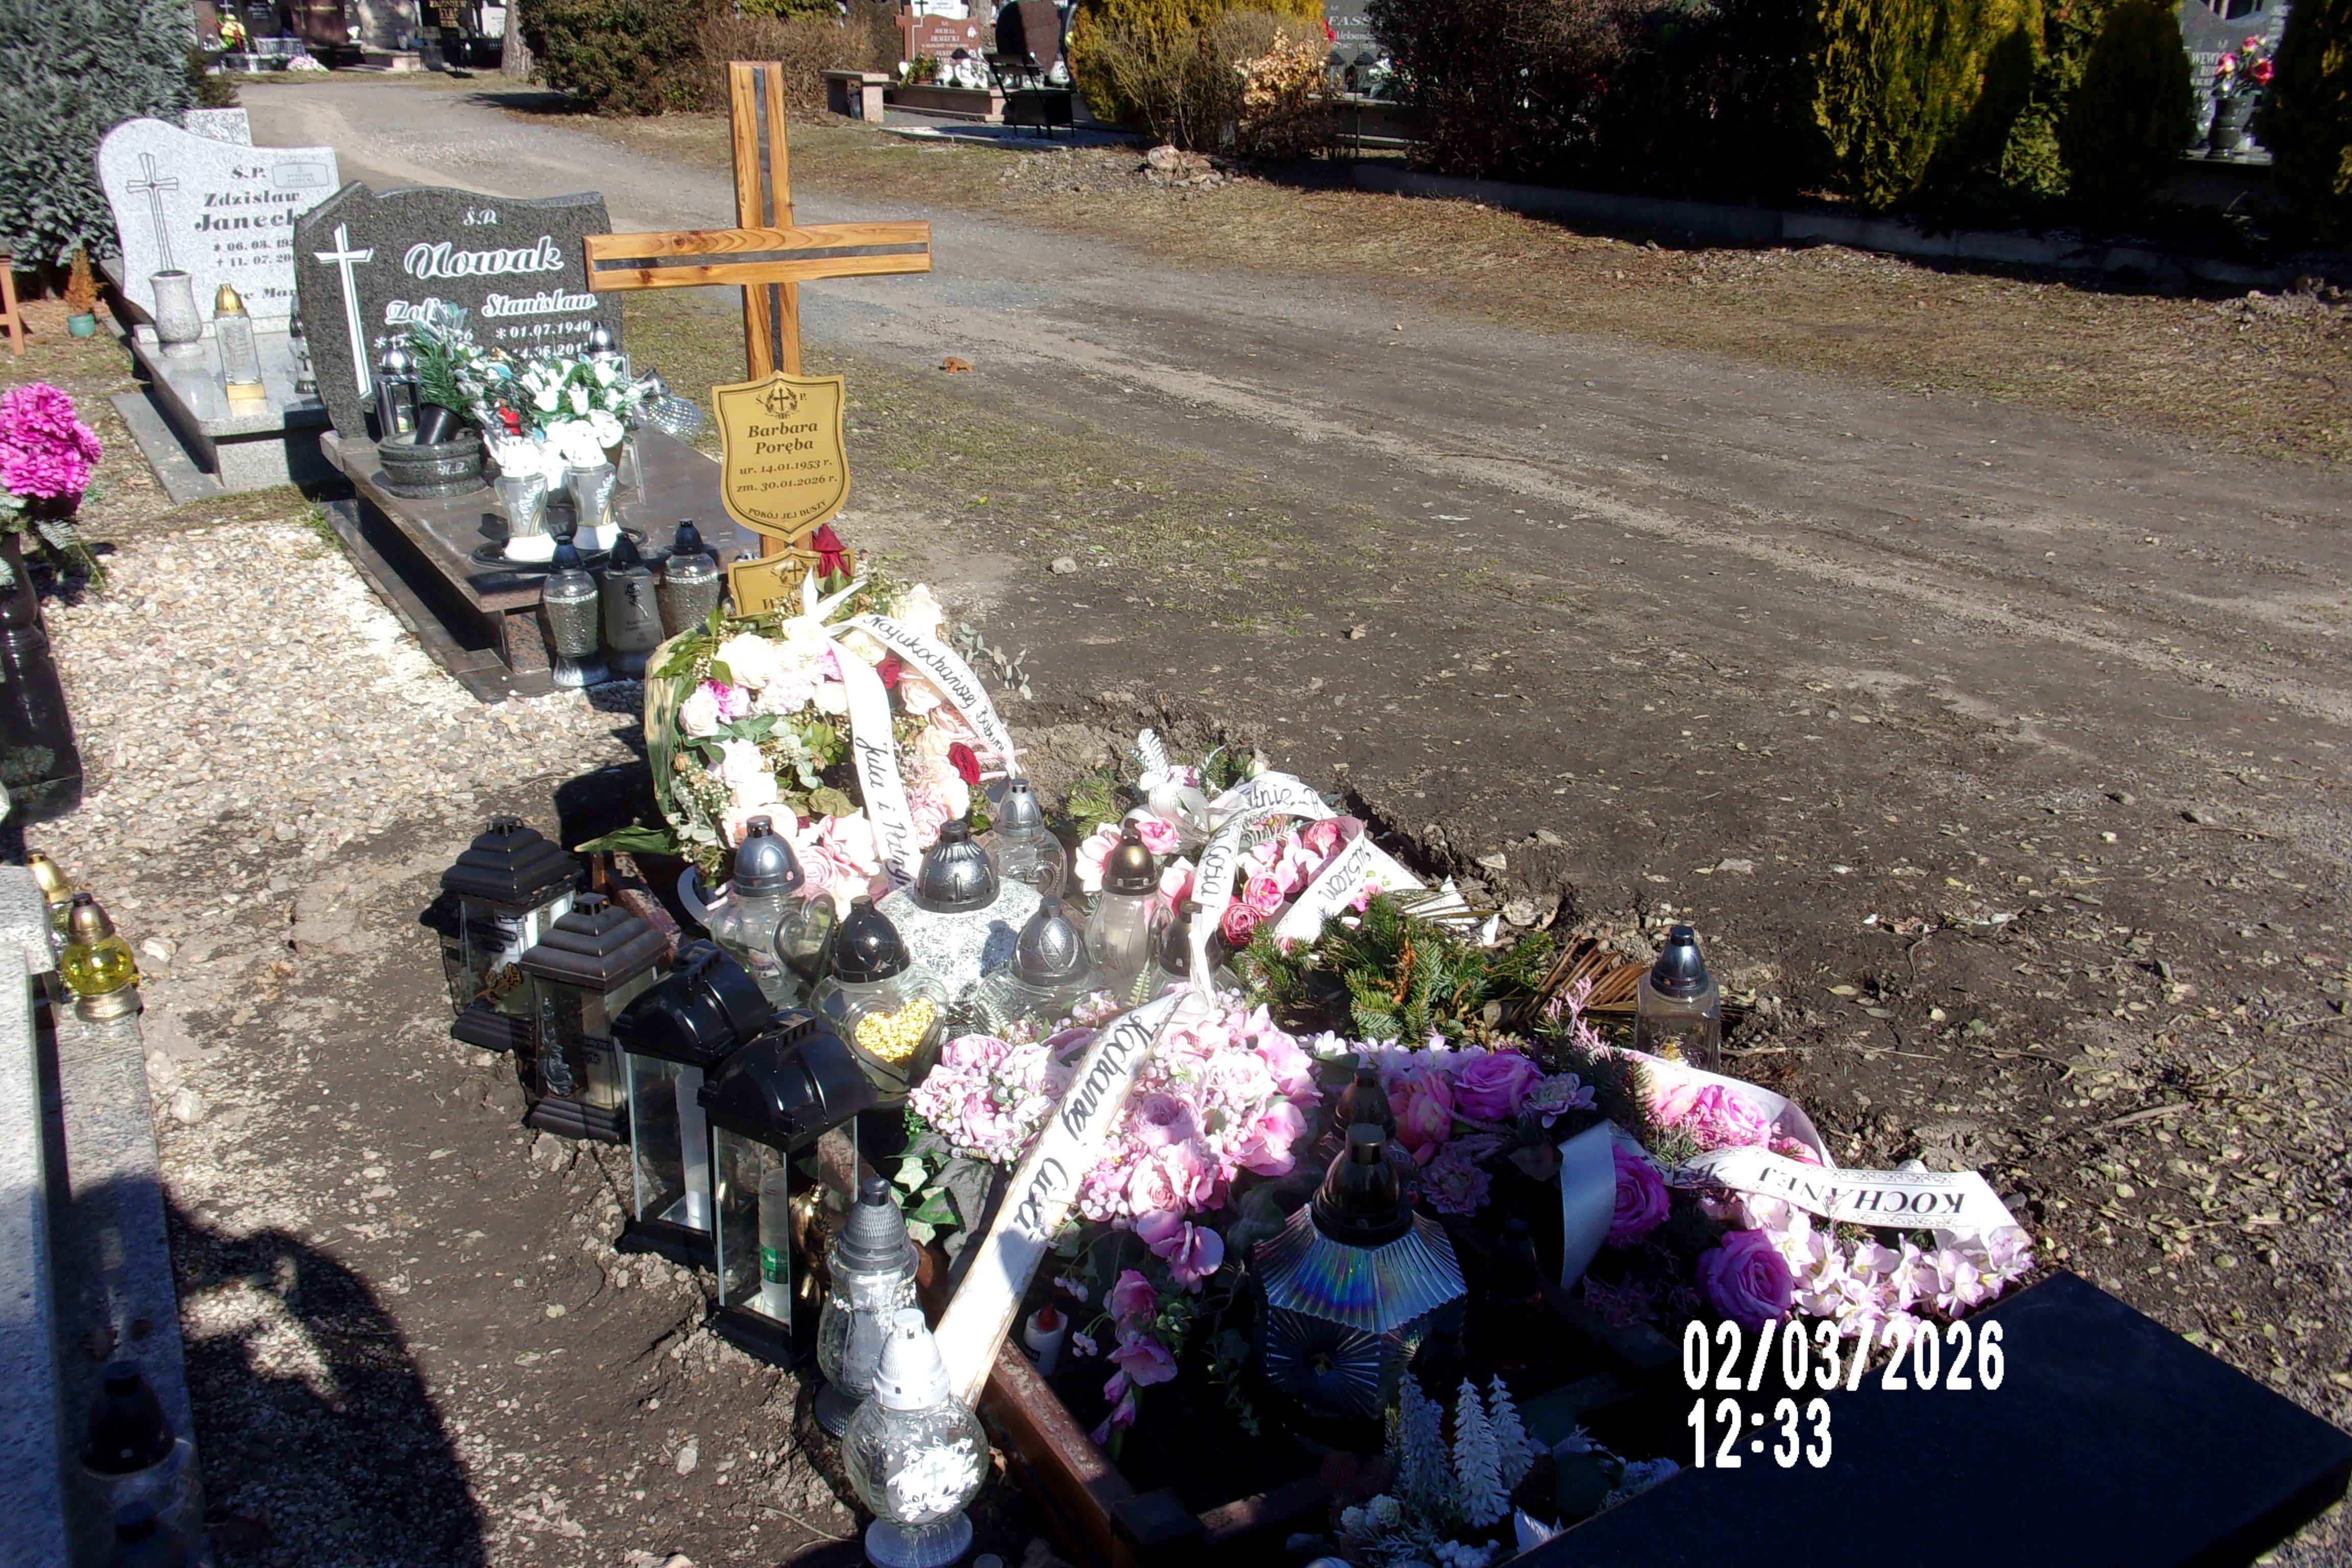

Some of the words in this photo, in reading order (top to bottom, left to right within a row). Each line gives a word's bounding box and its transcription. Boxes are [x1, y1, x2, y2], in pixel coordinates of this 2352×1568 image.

[204, 190, 300, 207] Zdzisław
[194, 207, 298, 232] Janeck
[404, 235, 565, 280] Nowak
[747, 421, 818, 438] Barbara
[754, 437, 814, 455] Poręba
[739, 466, 757, 475] ur.
[761, 459, 821, 474] 14.01.1953
[760, 475, 826, 492] 30.01.2026
[748, 507, 779, 520] POKÓJ
[799, 499, 827, 517] DUSZY
[855, 734, 889, 789] Jula
[880, 818, 913, 891] Patry
[1061, 1013, 1155, 1141] Kochanej
[1758, 1167, 1966, 1215] KOCHANEJ
